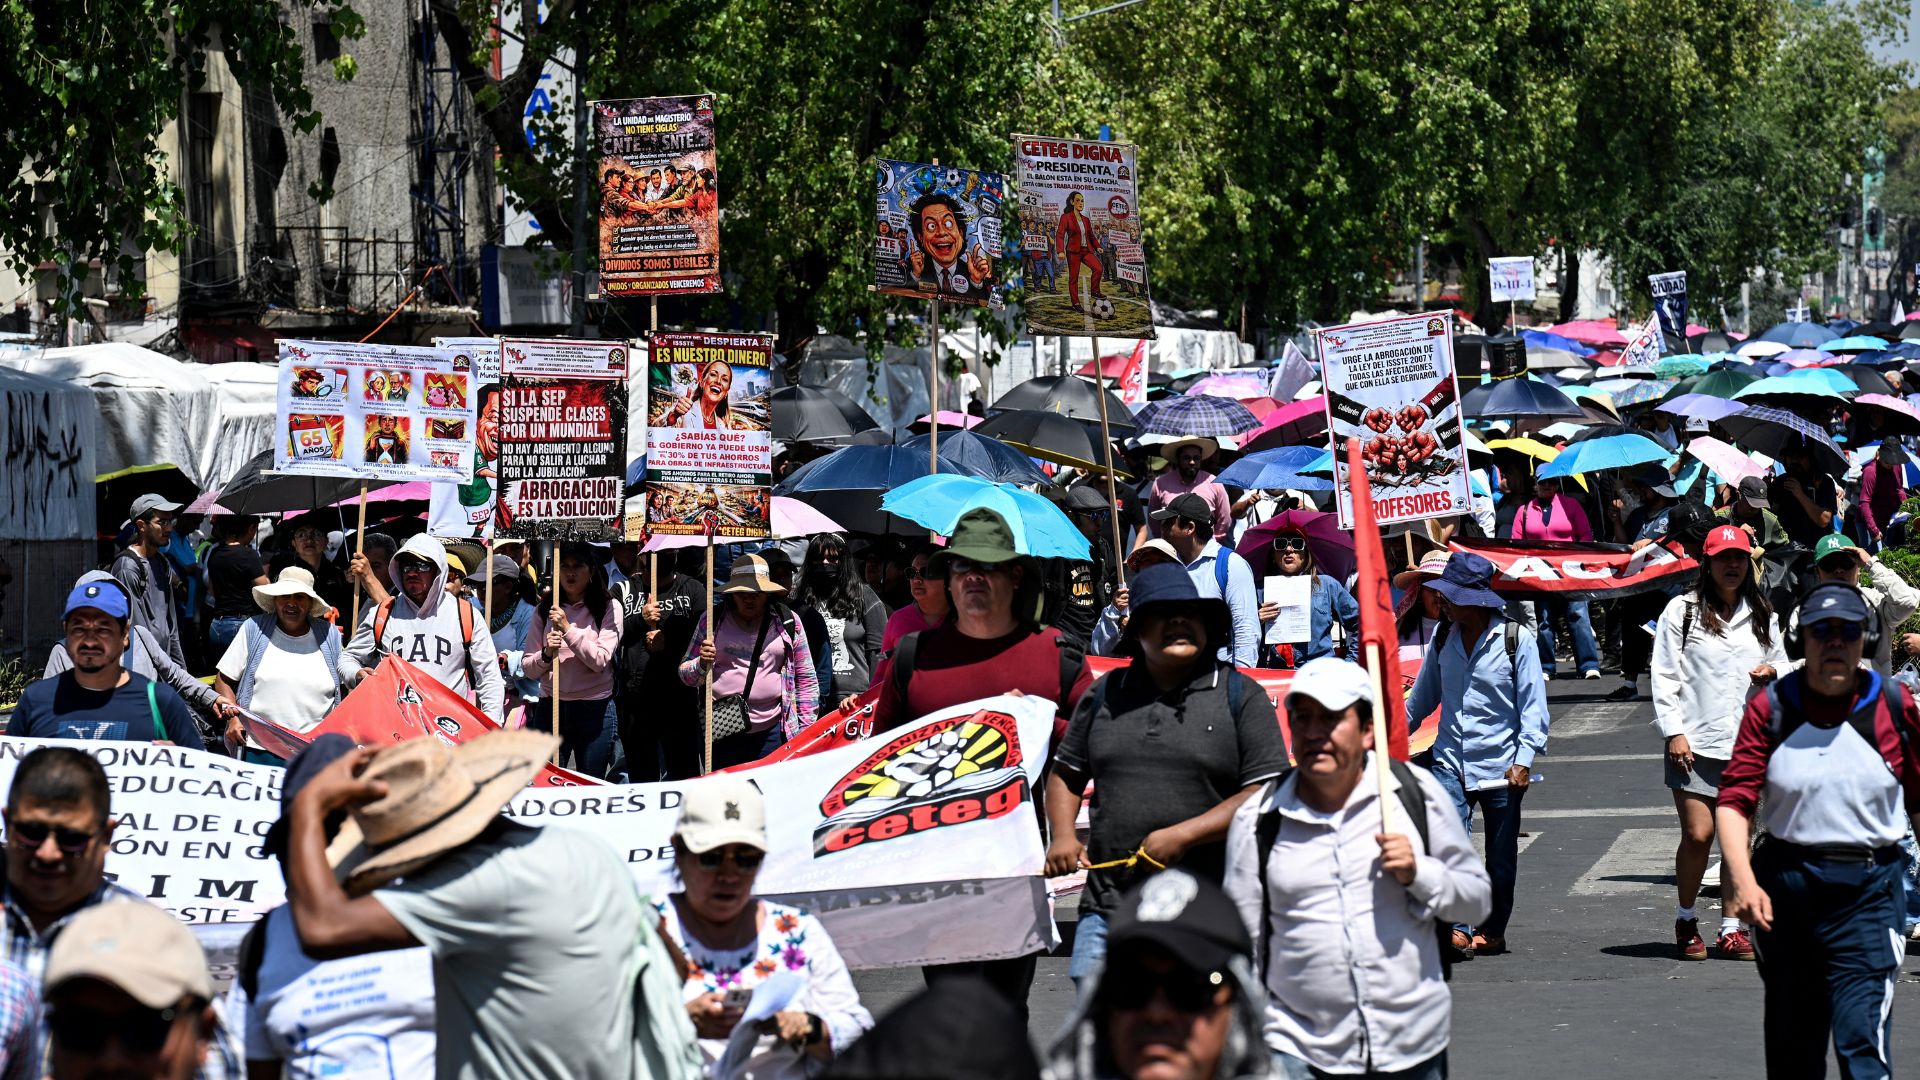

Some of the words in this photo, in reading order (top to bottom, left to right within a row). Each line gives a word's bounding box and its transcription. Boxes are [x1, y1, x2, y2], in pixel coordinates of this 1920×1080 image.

[623, 116, 646, 125] UNIDAD
[626, 126, 635, 134] NO
[636, 125, 654, 133] TIENE
[655, 123, 678, 132] SIGLAS
[1021, 141, 1068, 158] CETEG
[1072, 144, 1123, 163] DIGNA
[1035, 172, 1055, 180] BALÓN
[1057, 173, 1072, 181] ESTÁ
[1037, 161, 1115, 178] PRESIDENTA,
[1024, 196, 1037, 205] 43
[606, 259, 640, 271] DIVIDIDOS
[644, 258, 670, 269] SOMOS
[674, 256, 709, 268] DÉBILES
[1122, 270, 1136, 280] ¡YA!
[607, 282, 627, 290] UNIDOS
[632, 281, 669, 289] ORGANIZADOS
[670, 279, 704, 288] VENCEREMOS
[1651, 279, 1685, 295] CIUDAD
[704, 337, 759, 347] DESPIERTA
[656, 348, 671, 363] ES
[673, 348, 725, 363] NUESTRO
[728, 349, 769, 367] DINERO.
[1342, 353, 1362, 365] URGE
[1364, 352, 1373, 361] LA
[1375, 345, 1422, 360] ABROGACIÓN
[1424, 344, 1434, 353] DE
[1349, 364, 1357, 372] LA
[1359, 362, 1371, 372] LEY
[1373, 361, 1385, 370] DEL
[1387, 358, 1408, 368] ISSSTE
[1410, 355, 1427, 364] 2007
[1348, 371, 1370, 382] TODAS
[1372, 369, 1384, 378] LAS
[1385, 363, 1432, 376] AFECTACIONES
[1345, 380, 1358, 391] QUE
[1360, 378, 1373, 389] CON
[1375, 376, 1390, 386] ELLA
[1391, 375, 1399, 383] SE
[1401, 370, 1439, 383] DERIVARON.
[503, 390, 515, 406] SI
[521, 390, 537, 406] LA
[542, 390, 566, 406] SEP
[1430, 392, 1444, 406] AMLO
[503, 407, 561, 422] SUSPENDE
[566, 407, 606, 422] CLASES
[1337, 403, 1360, 417] Calderón
[300, 430, 323, 447] 65
[503, 423, 526, 439] POR
[530, 423, 546, 438] UN
[550, 423, 611, 437] MUNDIAL...
[675, 431, 717, 441] ¿SABÍAS
[720, 432, 745, 442] QUÉ?
[302, 445, 324, 455] AÑOS
[503, 444, 513, 454] NO
[516, 443, 531, 454] HAY
[533, 443, 580, 454] ARGUMENTO
[583, 443, 614, 453] ALGUNO
[660, 442, 703, 450] GOBIERNO
[719, 444, 745, 452] PUEDE
[749, 445, 770, 453] USAR
[502, 455, 524, 466] PARA
[527, 455, 538, 466] NO
[540, 455, 563, 466] SALIR
[565, 455, 571, 465] A
[574, 455, 606, 465] LUCHAR
[705, 461, 770, 470] INFRAESTRUCTURA
[502, 467, 520, 478] POR
[523, 467, 533, 477] LA
[536, 464, 588, 477] JUBILACIÓN.
[519, 477, 617, 500] ABROGACIÓN
[518, 502, 533, 517] ES
[537, 501, 552, 517] LA
[557, 498, 616, 516] SOLUCIÓN
[1372, 490, 1452, 520] ROFESORES
[472, 509, 489, 521] SEP
[1722, 528, 1736, 540] NY
[390, 633, 452, 666] GAP
[0, 741, 195, 769] NONAL
[824, 779, 1025, 851] ceteg
[172, 814, 222, 832] DE
[182, 841, 232, 859] EN
